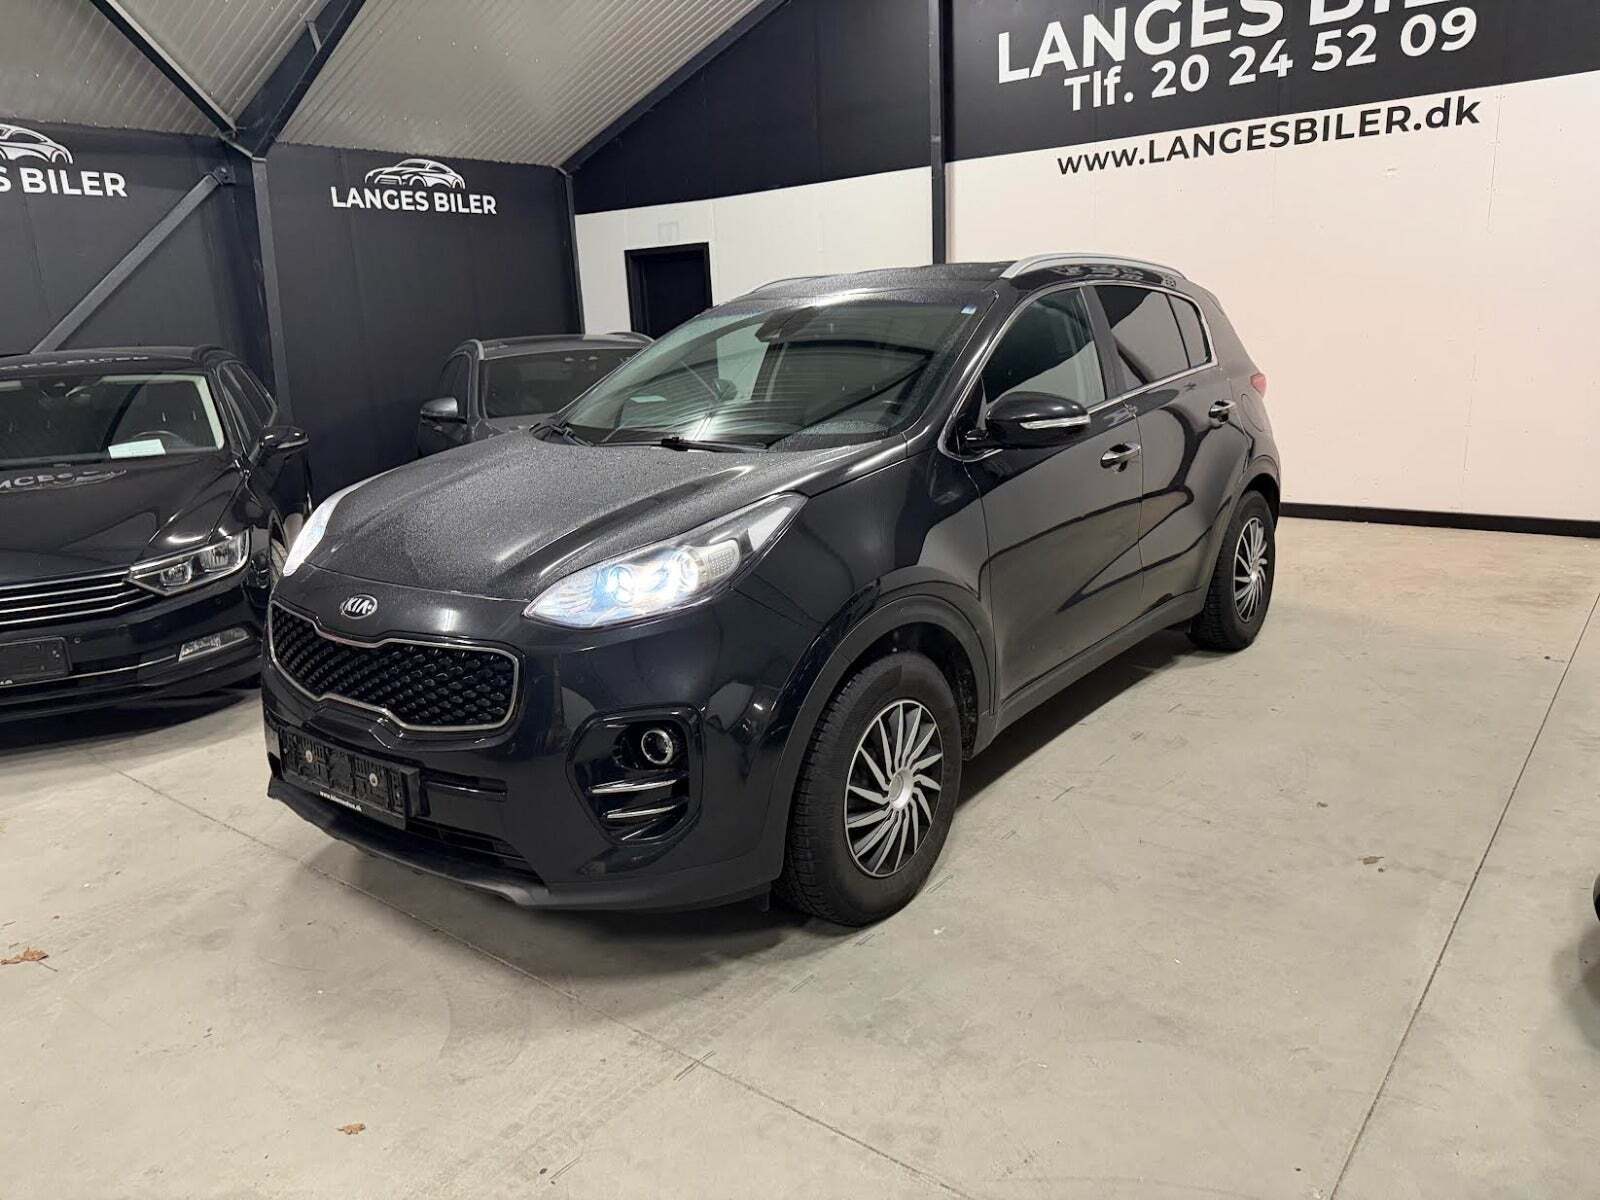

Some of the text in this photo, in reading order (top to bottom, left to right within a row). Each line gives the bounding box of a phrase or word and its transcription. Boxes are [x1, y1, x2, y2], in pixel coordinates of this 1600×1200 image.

[998, 0, 1284, 84] LANGES
[1063, 65, 1134, 112] Tlf.
[1151, 54, 1210, 99] 20
[1228, 39, 1294, 86] 24
[1311, 24, 1377, 72] 52
[1400, 7, 1477, 57] 09
[1057, 95, 1481, 175] www.LANGESBILER.dk
[19, 167, 128, 198] BILER
[330, 186, 497, 215] LANGES BILER
